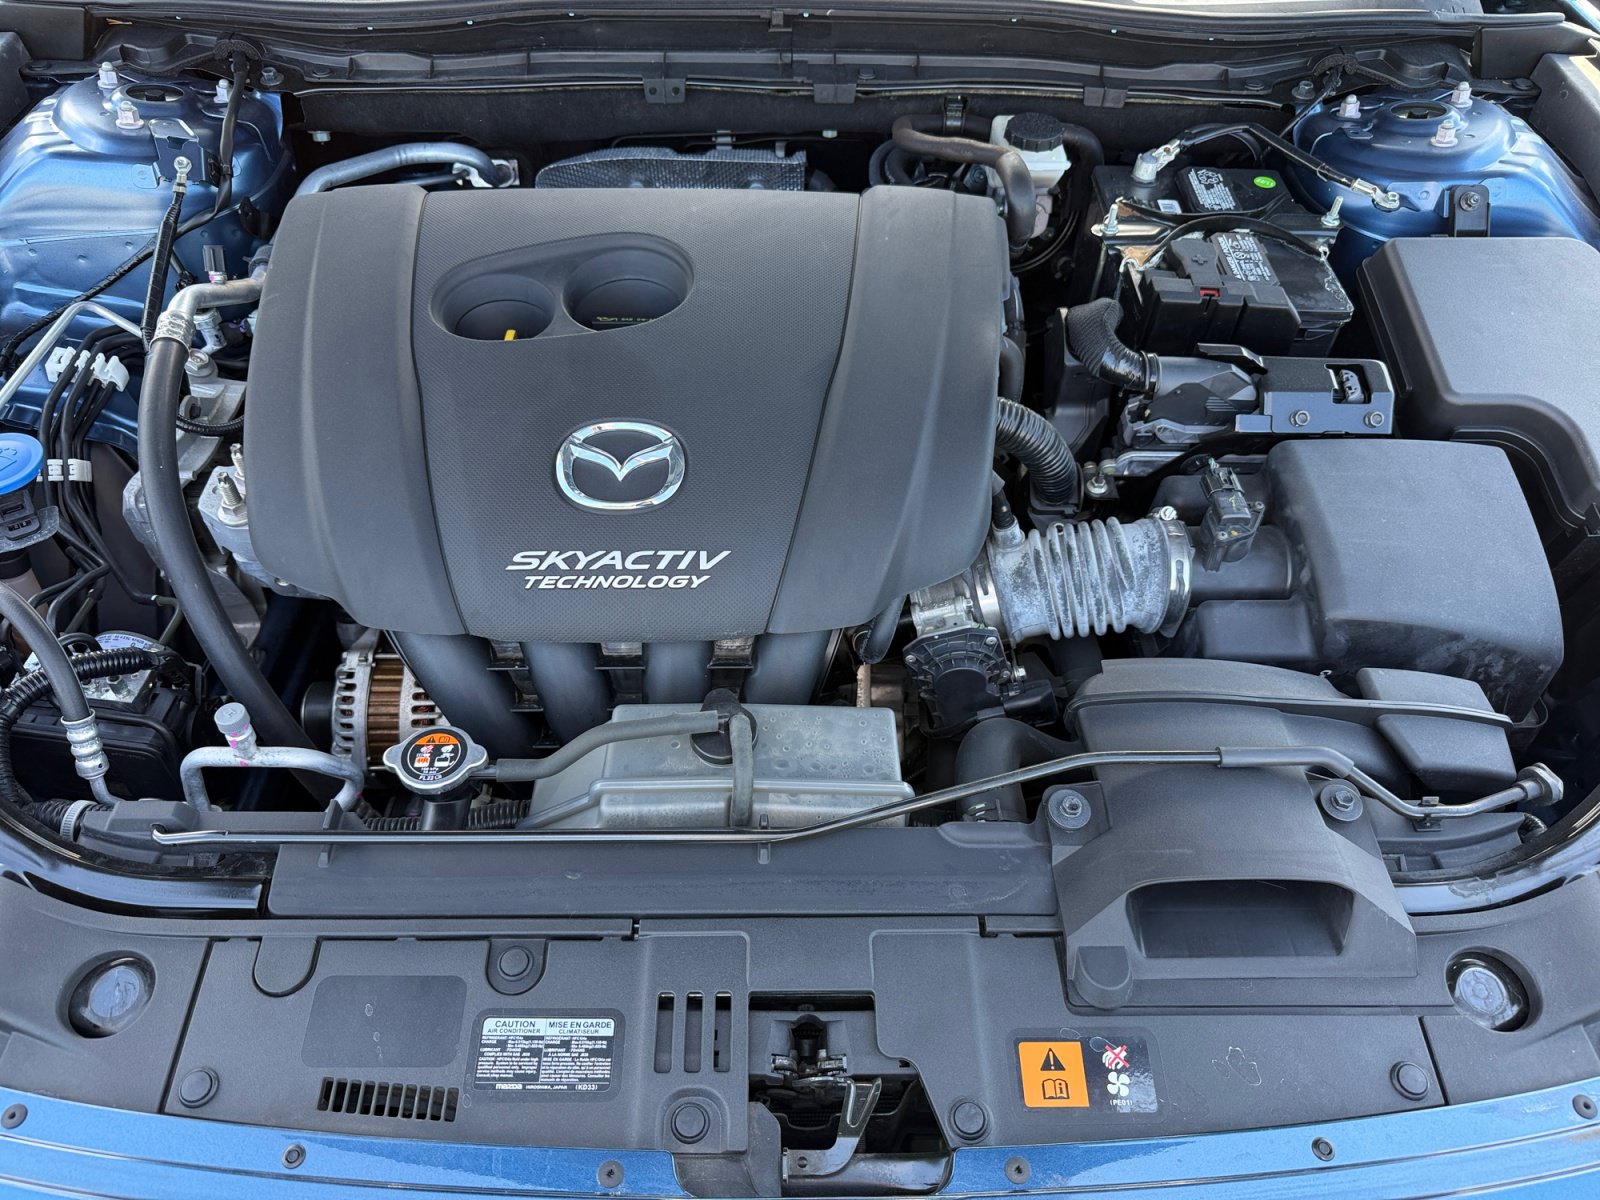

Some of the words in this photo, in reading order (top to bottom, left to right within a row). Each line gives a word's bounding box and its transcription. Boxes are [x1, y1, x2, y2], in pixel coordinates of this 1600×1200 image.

[505, 550, 732, 570] SKYACTIV
[525, 575, 711, 589] TECHNOLOGY
[495, 1020, 536, 1028] CAUTION
[548, 1021, 568, 1029] MISE
[570, 1021, 582, 1029] EN
[582, 1021, 612, 1029] GARDE
